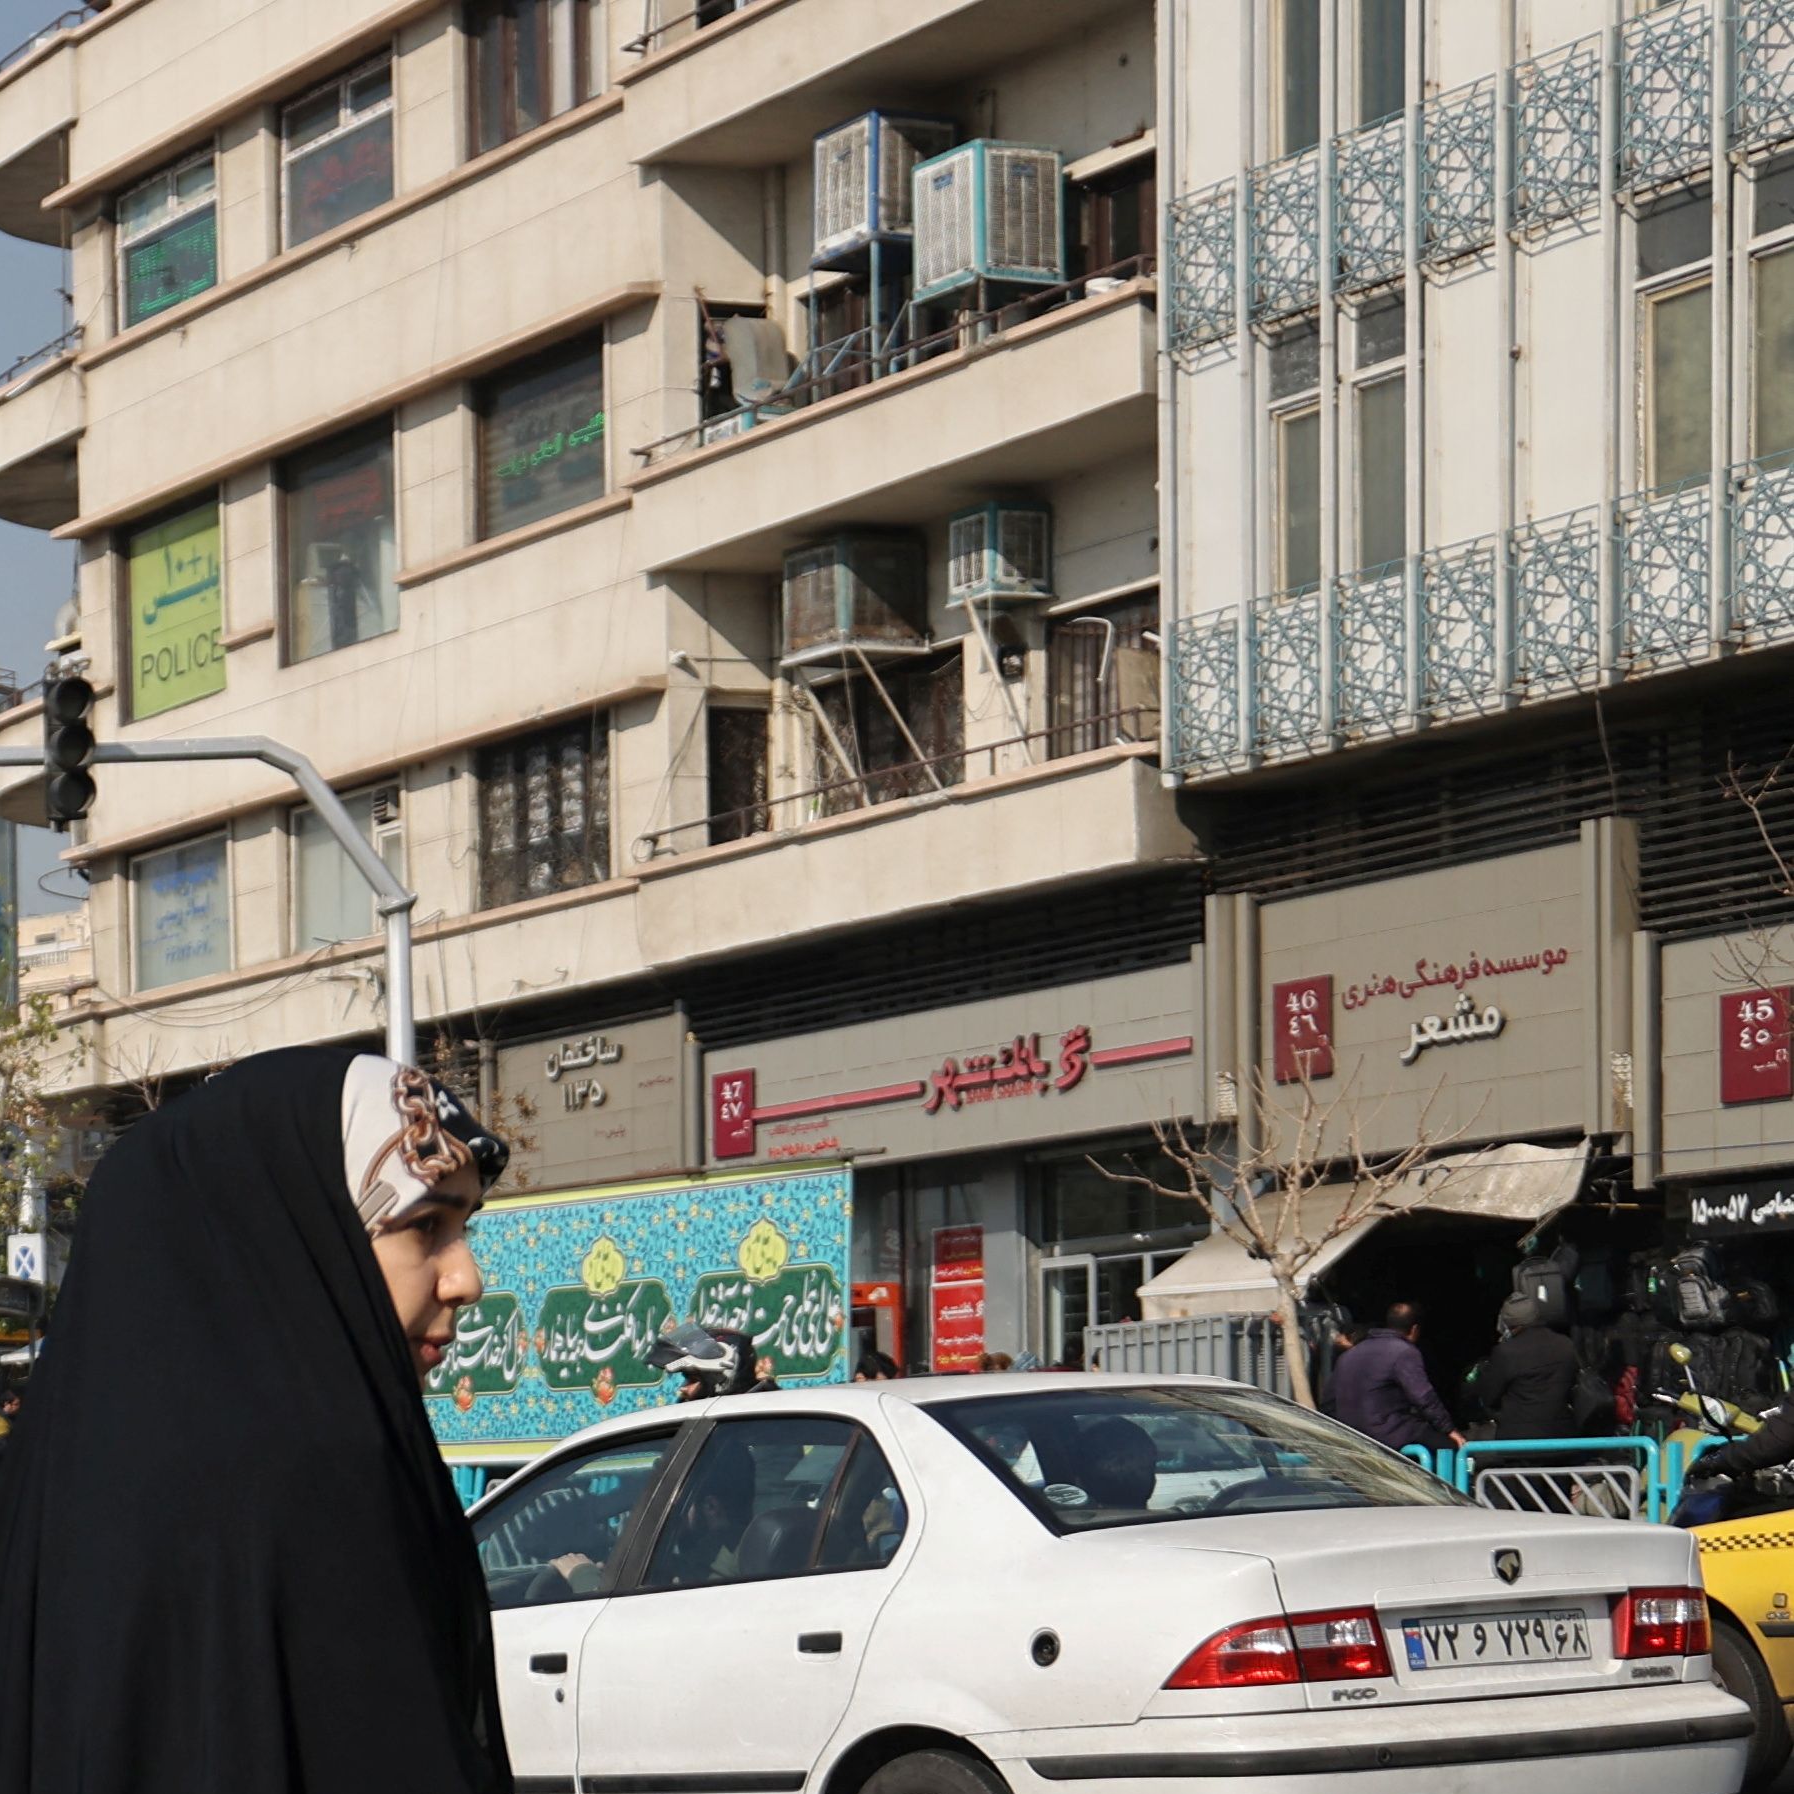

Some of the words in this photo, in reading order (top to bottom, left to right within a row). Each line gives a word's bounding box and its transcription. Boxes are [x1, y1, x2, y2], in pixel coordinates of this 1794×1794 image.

[141, 626, 224, 690] POLICE
[1399, 951, 1481, 999] فرهنگی
[1482, 947, 1569, 977] موسسه
[1285, 989, 1318, 1013] 46
[1341, 973, 1397, 1011] هنری
[1737, 998, 1775, 1023] 45
[1399, 992, 1502, 1064] مشعر
[545, 1036, 622, 1080] ساختمان
[720, 1080, 743, 1100] 47
[1424, 1623, 1459, 1661] ۷۲
[1473, 1622, 1487, 1657] و
[1497, 1617, 1552, 1657] ۷۲۹
[1554, 1623, 1588, 1655] ۶۸
